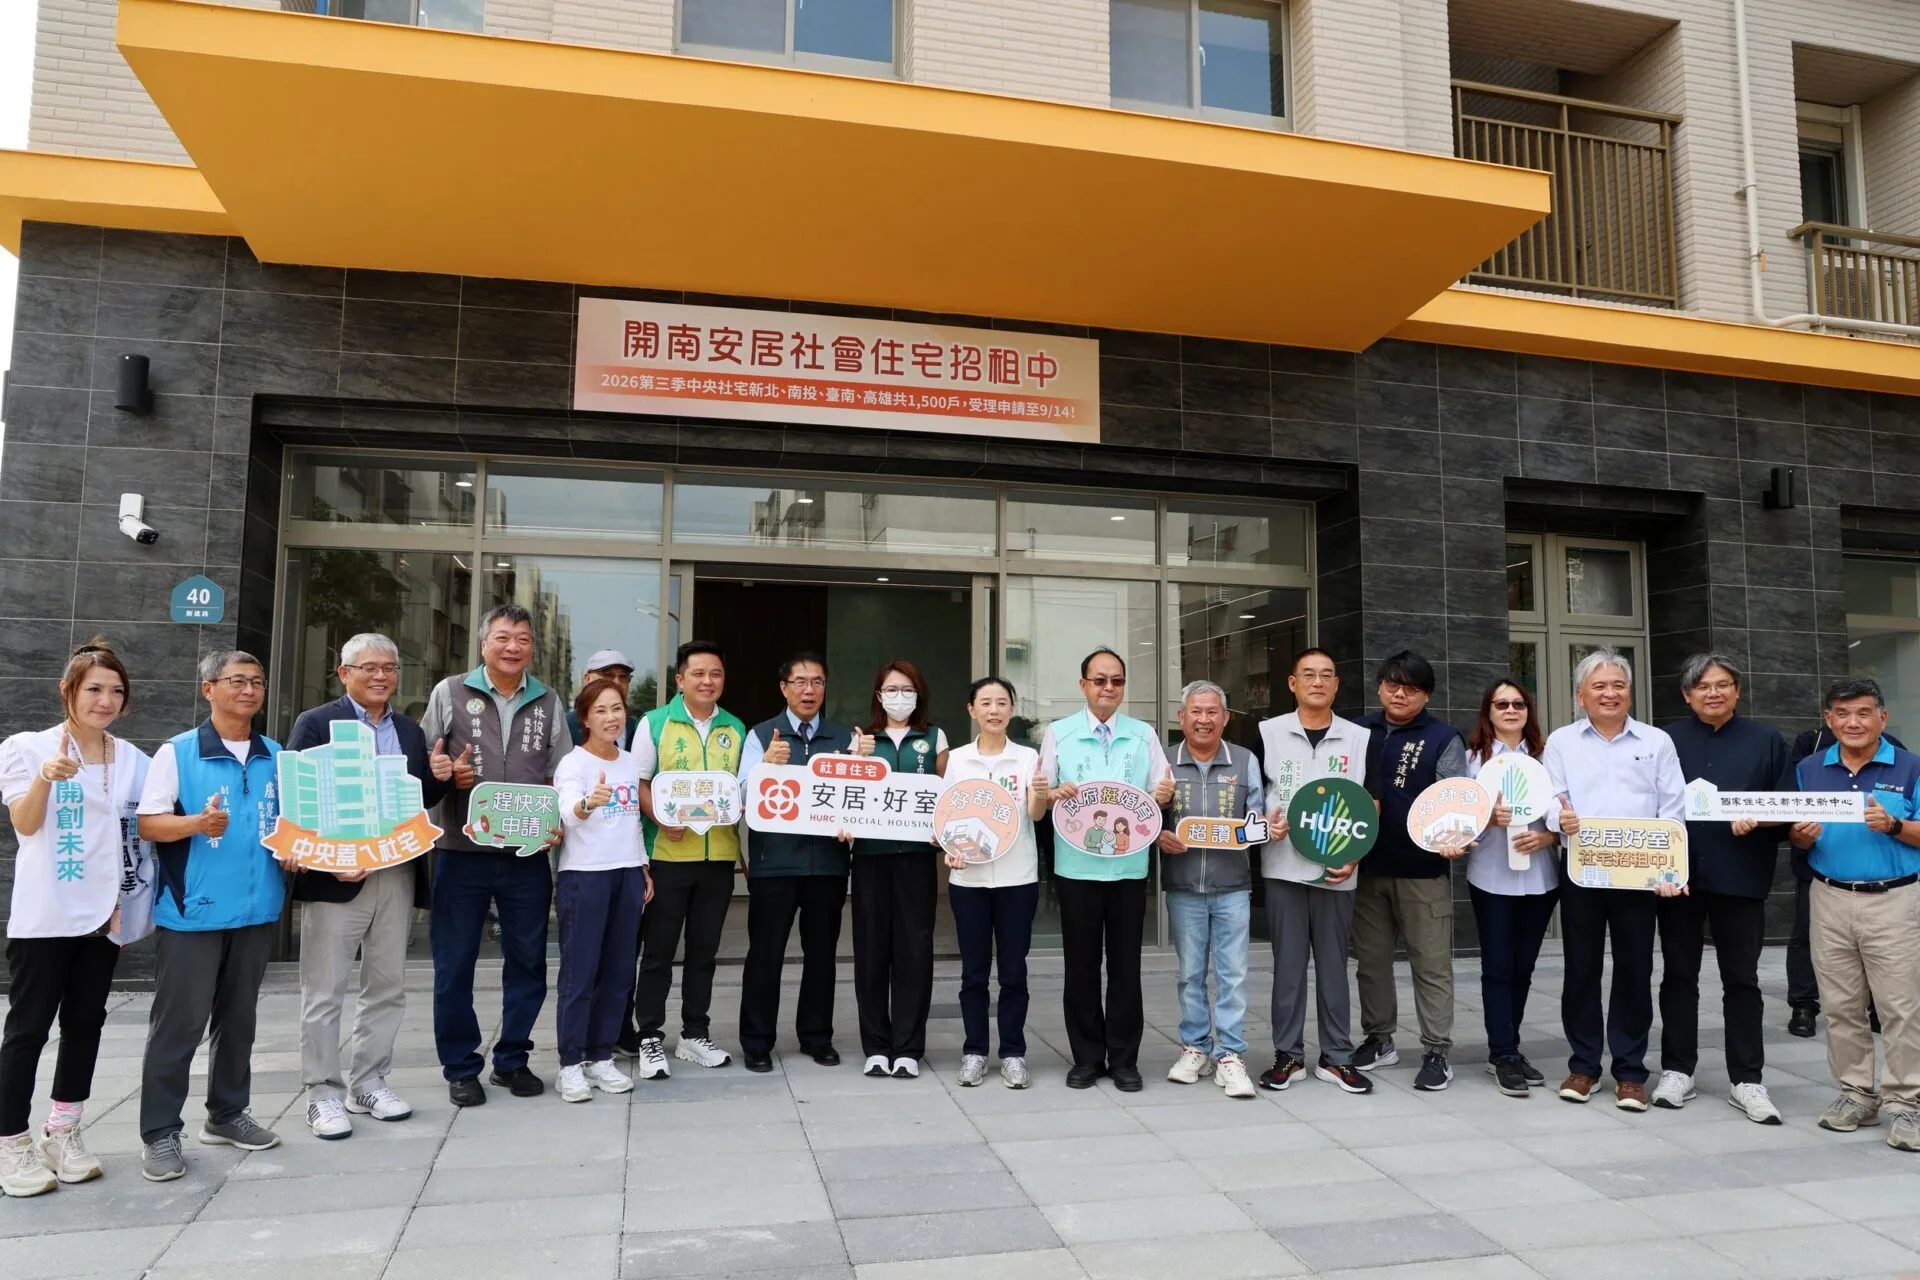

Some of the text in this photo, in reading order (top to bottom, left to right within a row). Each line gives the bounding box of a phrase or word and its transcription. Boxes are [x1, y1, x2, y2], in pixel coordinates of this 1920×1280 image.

[623, 319, 1058, 388] 開南安居社會住宅招租中
[186, 588, 211, 605] 40
[471, 718, 482, 738] 特助
[533, 705, 546, 751] 林俊憲
[819, 761, 877, 778] 社會住宅
[492, 790, 554, 814] 趕快來
[948, 787, 1013, 825] 好舒適
[1062, 786, 1155, 822] 政府挺婚育
[1417, 786, 1478, 817] 好舒適
[1720, 796, 1853, 808] 國家住宅及都市更新中心
[56, 781, 84, 882] 開創未來
[809, 813, 836, 823] HURC
[842, 816, 883, 826] SOCIAL
[1300, 811, 1368, 839] HURC
[1187, 822, 1231, 843] 超讚
[1579, 826, 1670, 849] 安居好室
